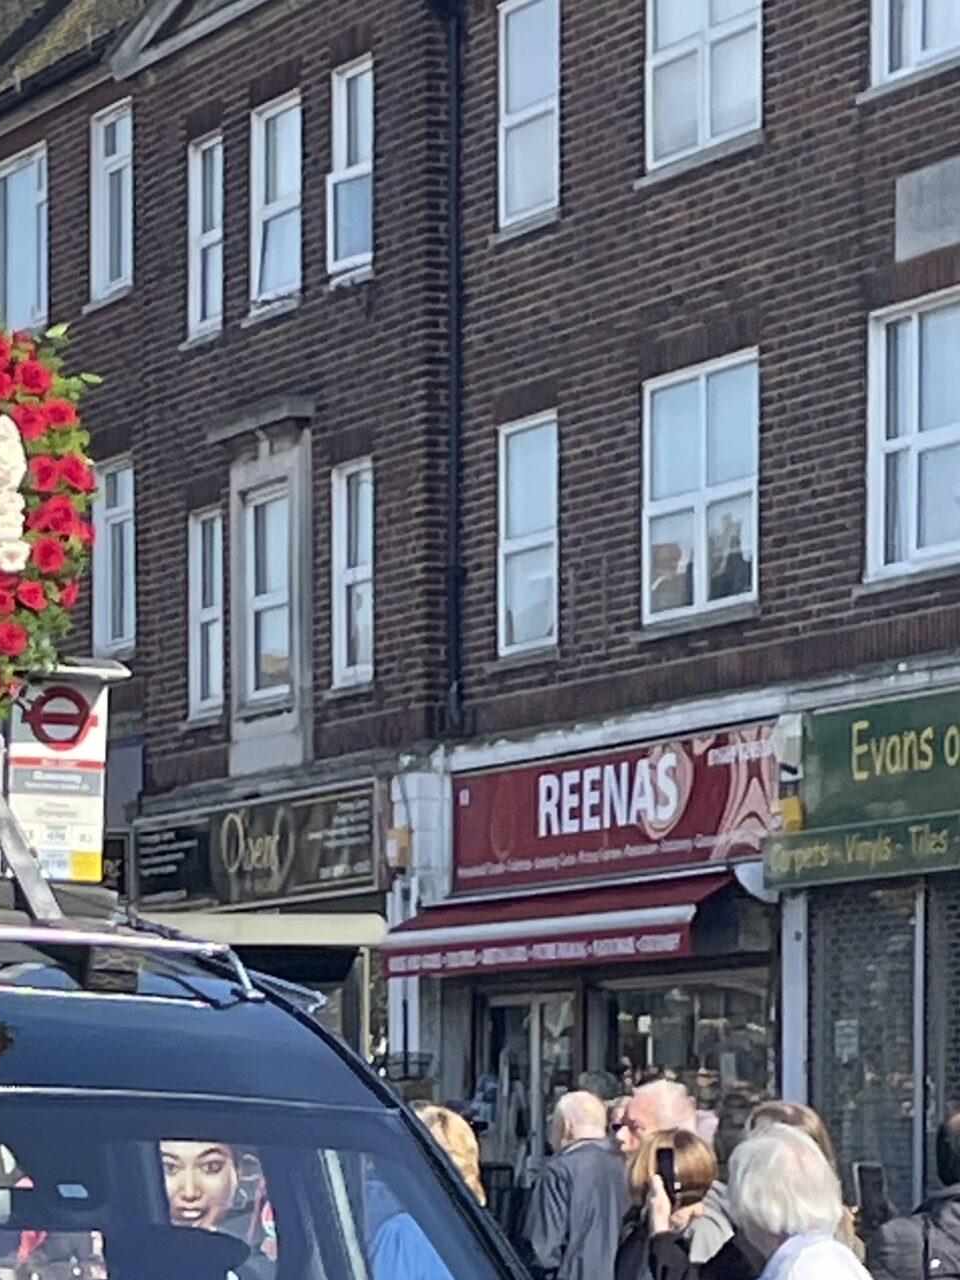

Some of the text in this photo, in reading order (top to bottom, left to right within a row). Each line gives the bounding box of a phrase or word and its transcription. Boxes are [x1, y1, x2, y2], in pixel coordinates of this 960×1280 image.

[851, 720, 933, 781] Evans
[538, 752, 678, 839] REENAS
[908, 823, 948, 855] Tiles
